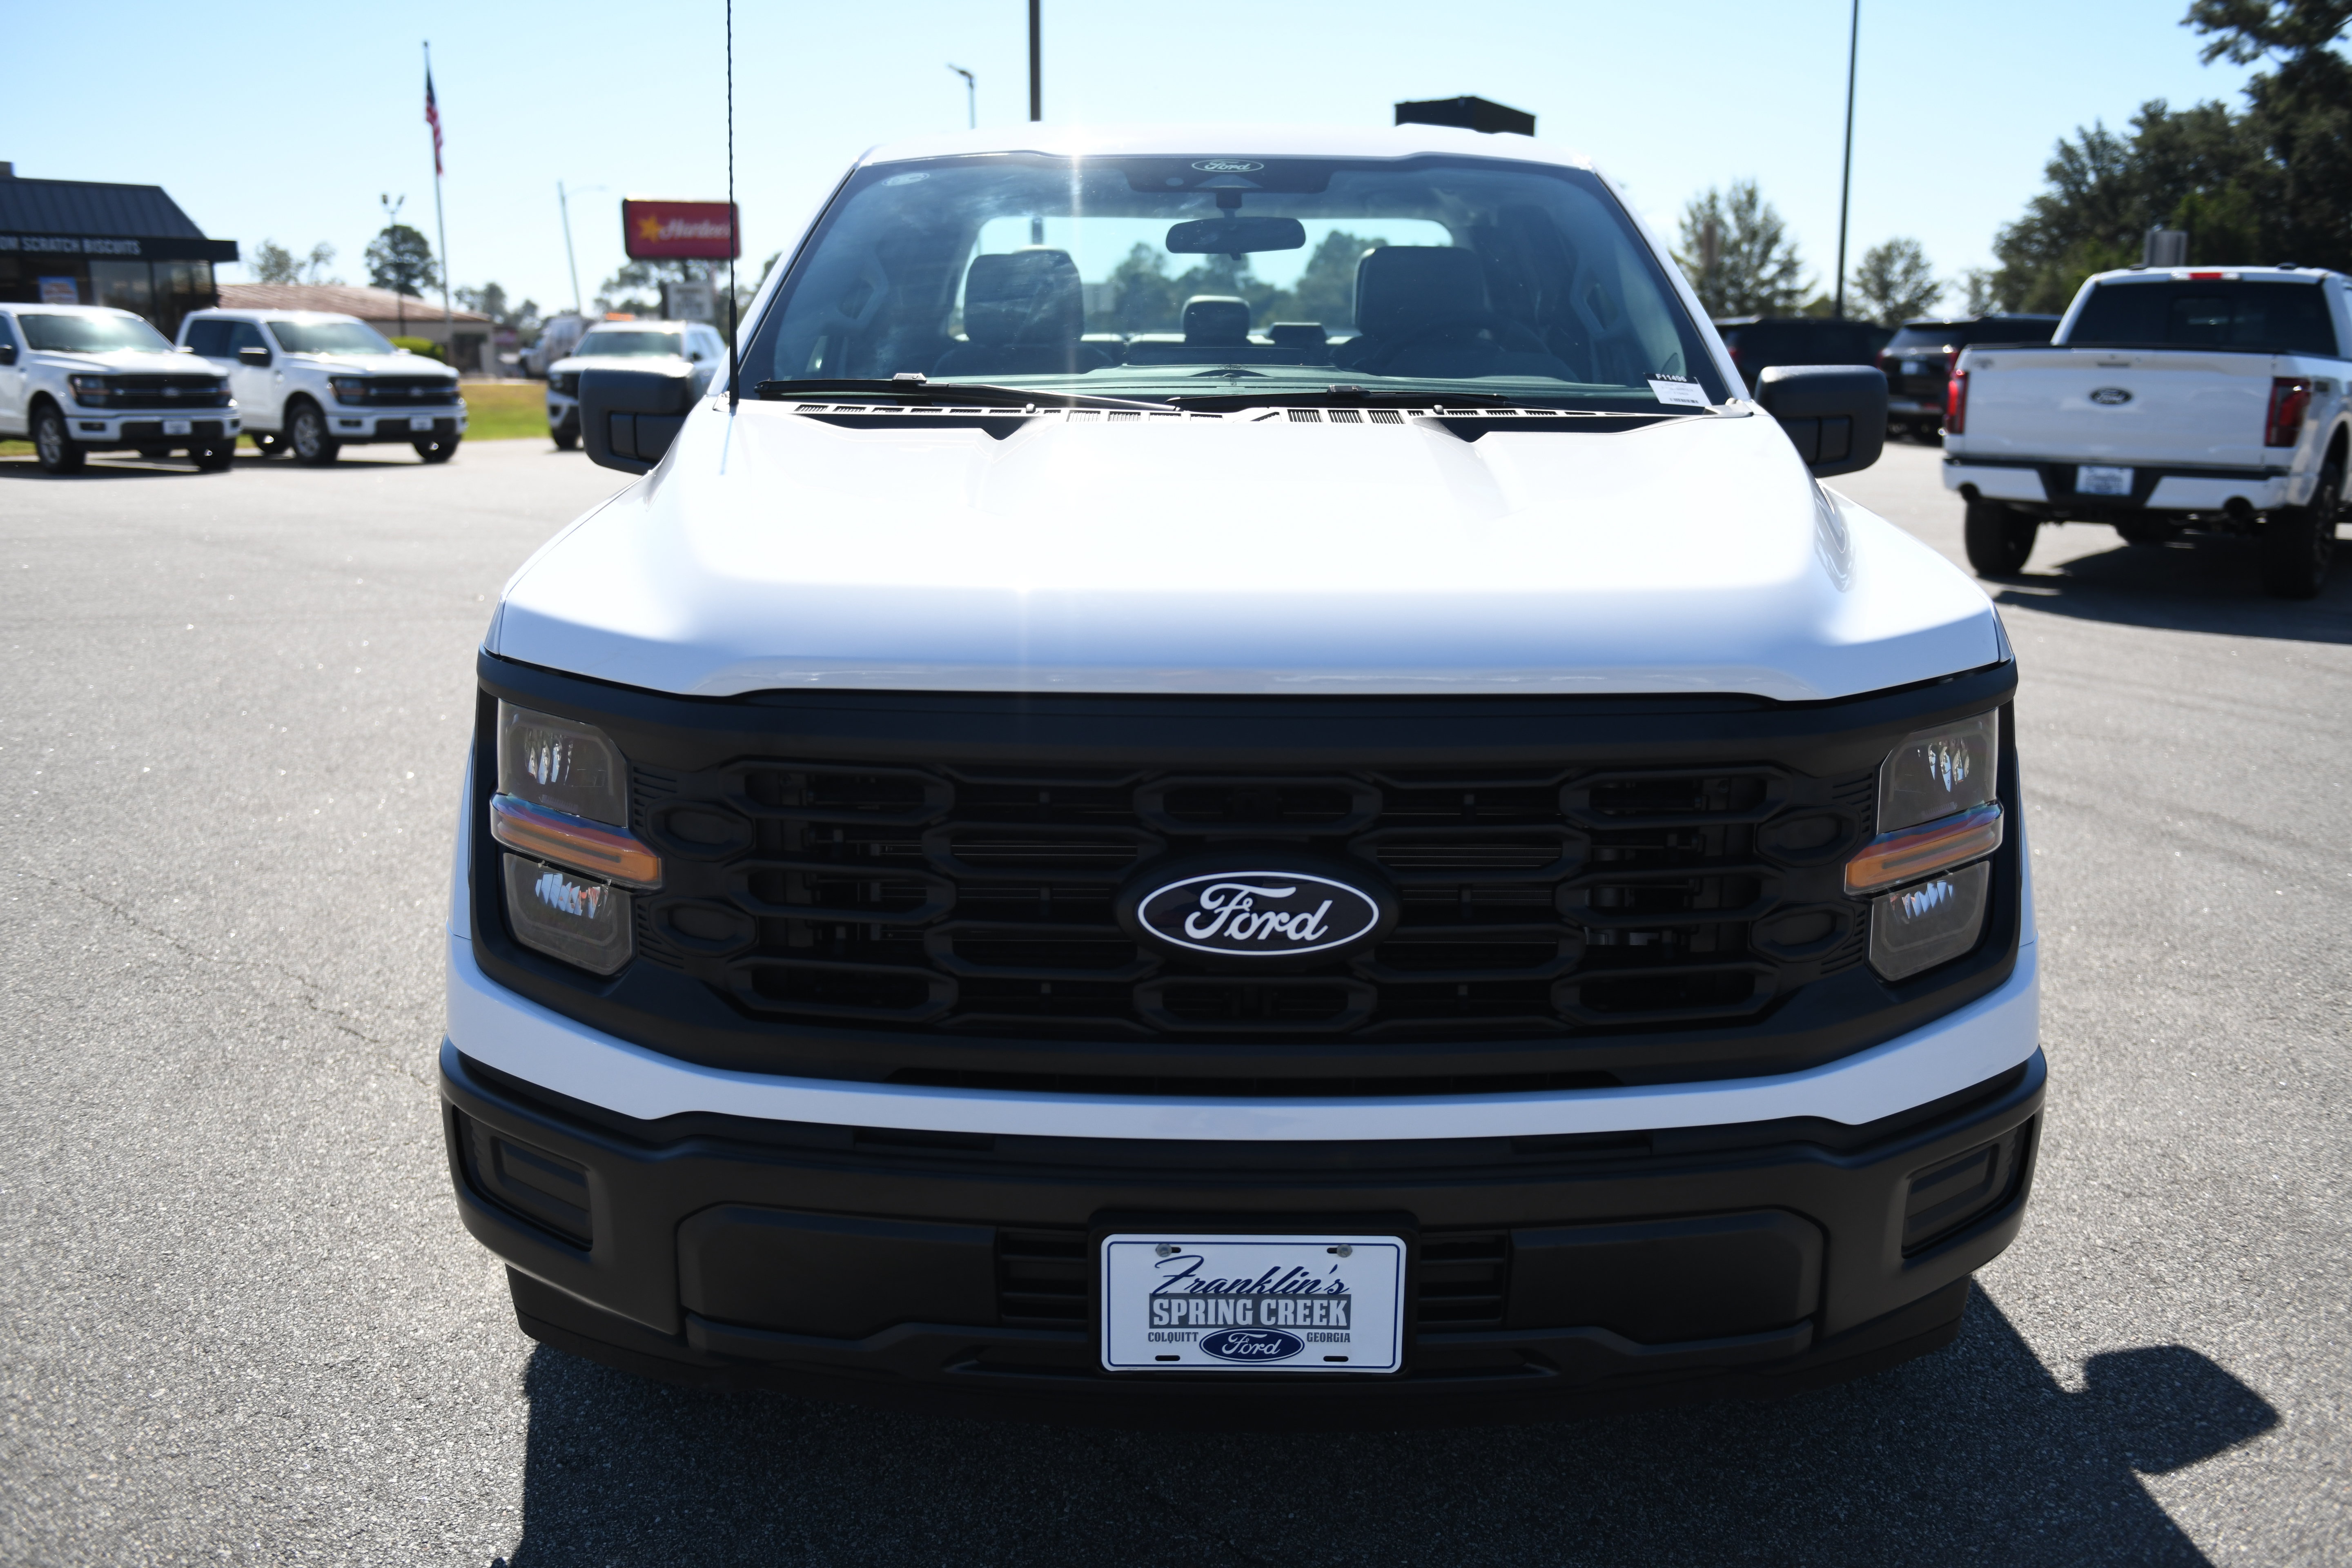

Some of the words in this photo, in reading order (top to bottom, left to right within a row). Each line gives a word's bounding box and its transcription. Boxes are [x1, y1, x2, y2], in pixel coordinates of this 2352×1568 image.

[1204, 160, 1251, 170] Ford
[21, 236, 80, 253] SCRATCH
[82, 238, 142, 255] BISCUITS
[1655, 373, 1687, 382] F11496
[1185, 883, 1333, 941] Ford
[1152, 1255, 1350, 1297] Franklin's
[1153, 1298, 1254, 1325] SPRING
[1260, 1299, 1348, 1326] CREEK
[1147, 1332, 1199, 1344] COLQUITT
[1222, 1332, 1283, 1355] Ford
[1307, 1332, 1351, 1343] GEORGIA
